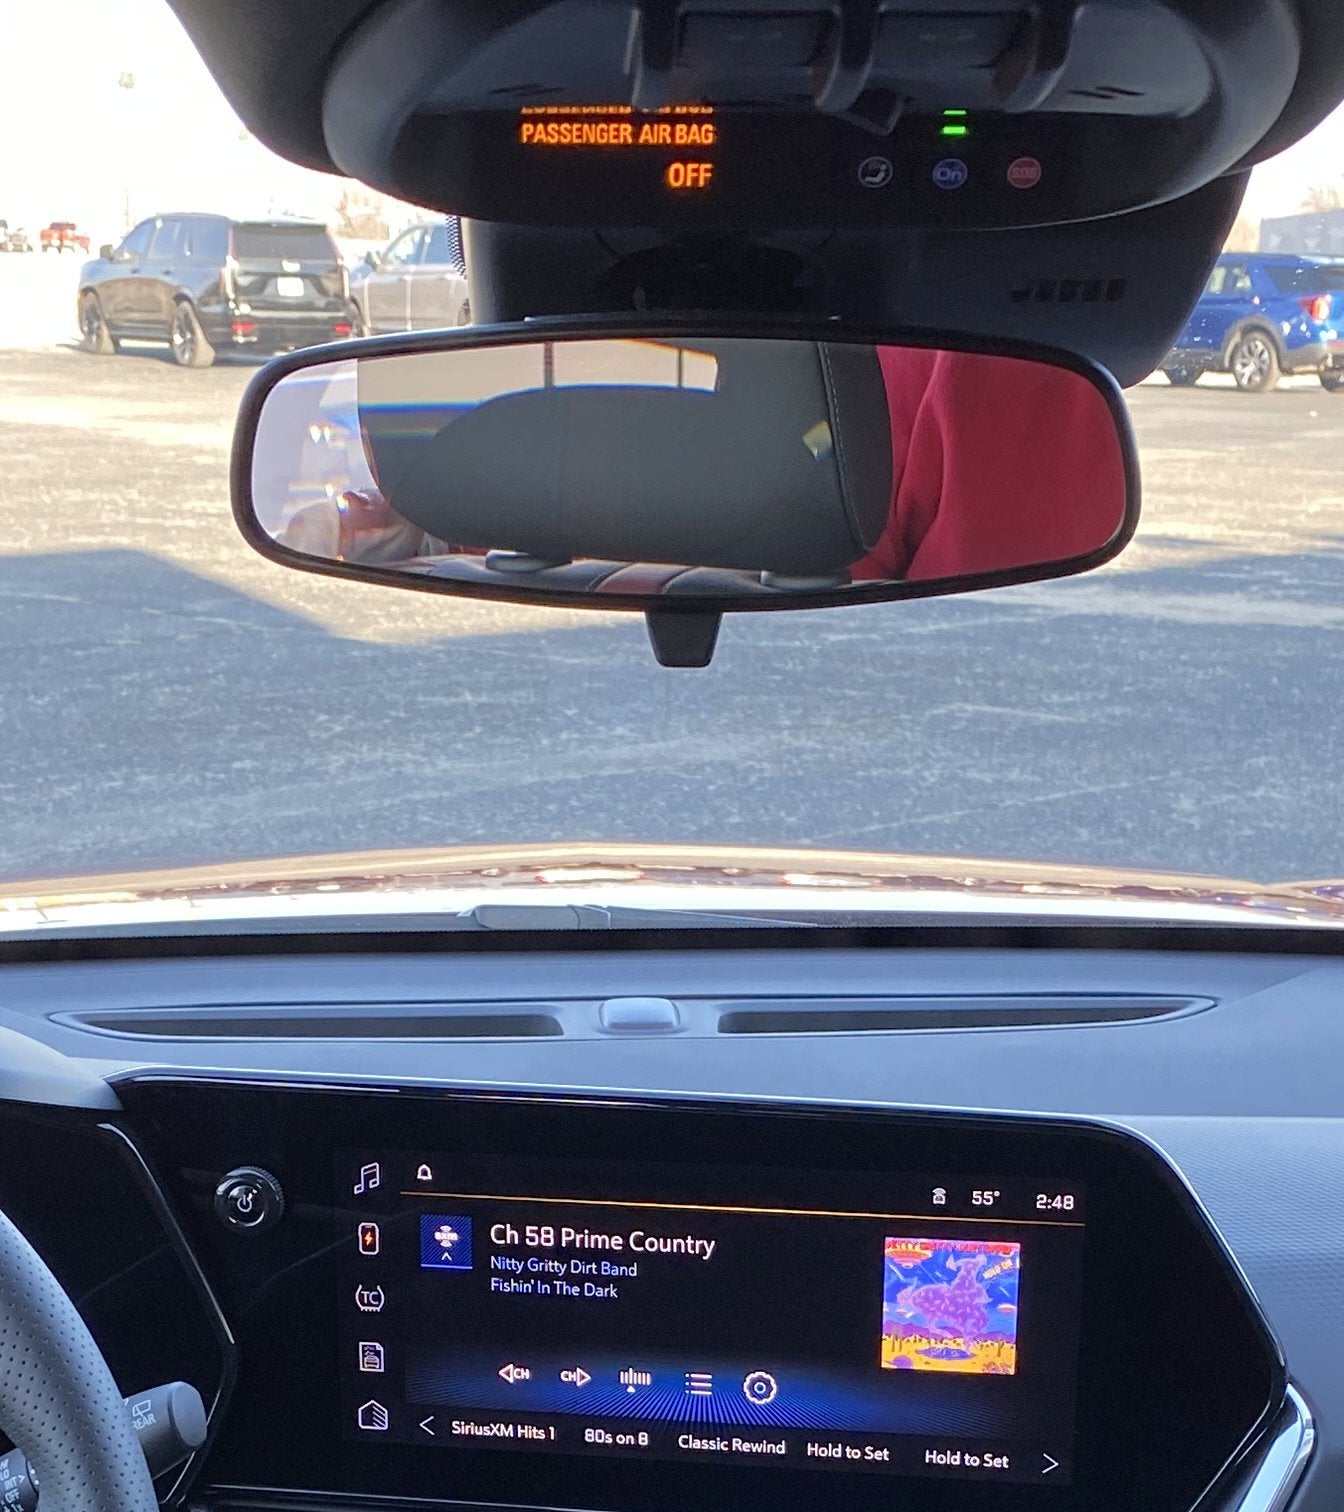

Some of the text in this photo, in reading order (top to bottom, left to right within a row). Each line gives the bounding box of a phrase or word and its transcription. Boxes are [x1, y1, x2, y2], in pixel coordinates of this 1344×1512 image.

[520, 122, 714, 144] PASSENGER AIR BAG
[668, 162, 713, 187] OFF
[936, 166, 962, 180] On
[1012, 167, 1037, 179] SOS
[971, 1190, 1001, 1206] 55°
[1036, 1194, 1074, 1210] 2:48
[490, 1224, 715, 1260] Ch 58 Prime Country
[491, 1256, 637, 1277] Nitty Gritty Dirt Band
[491, 1278, 618, 1298] Fishin' In The Dark
[514, 1368, 530, 1379] CH
[451, 1420, 555, 1440] SiriusXM Hits 1
[585, 1428, 648, 1446] 80s on 8
[678, 1434, 786, 1455] Classic Rewind
[807, 1442, 890, 1461] Hold to Set
[925, 1449, 1009, 1469] Hold to Set
